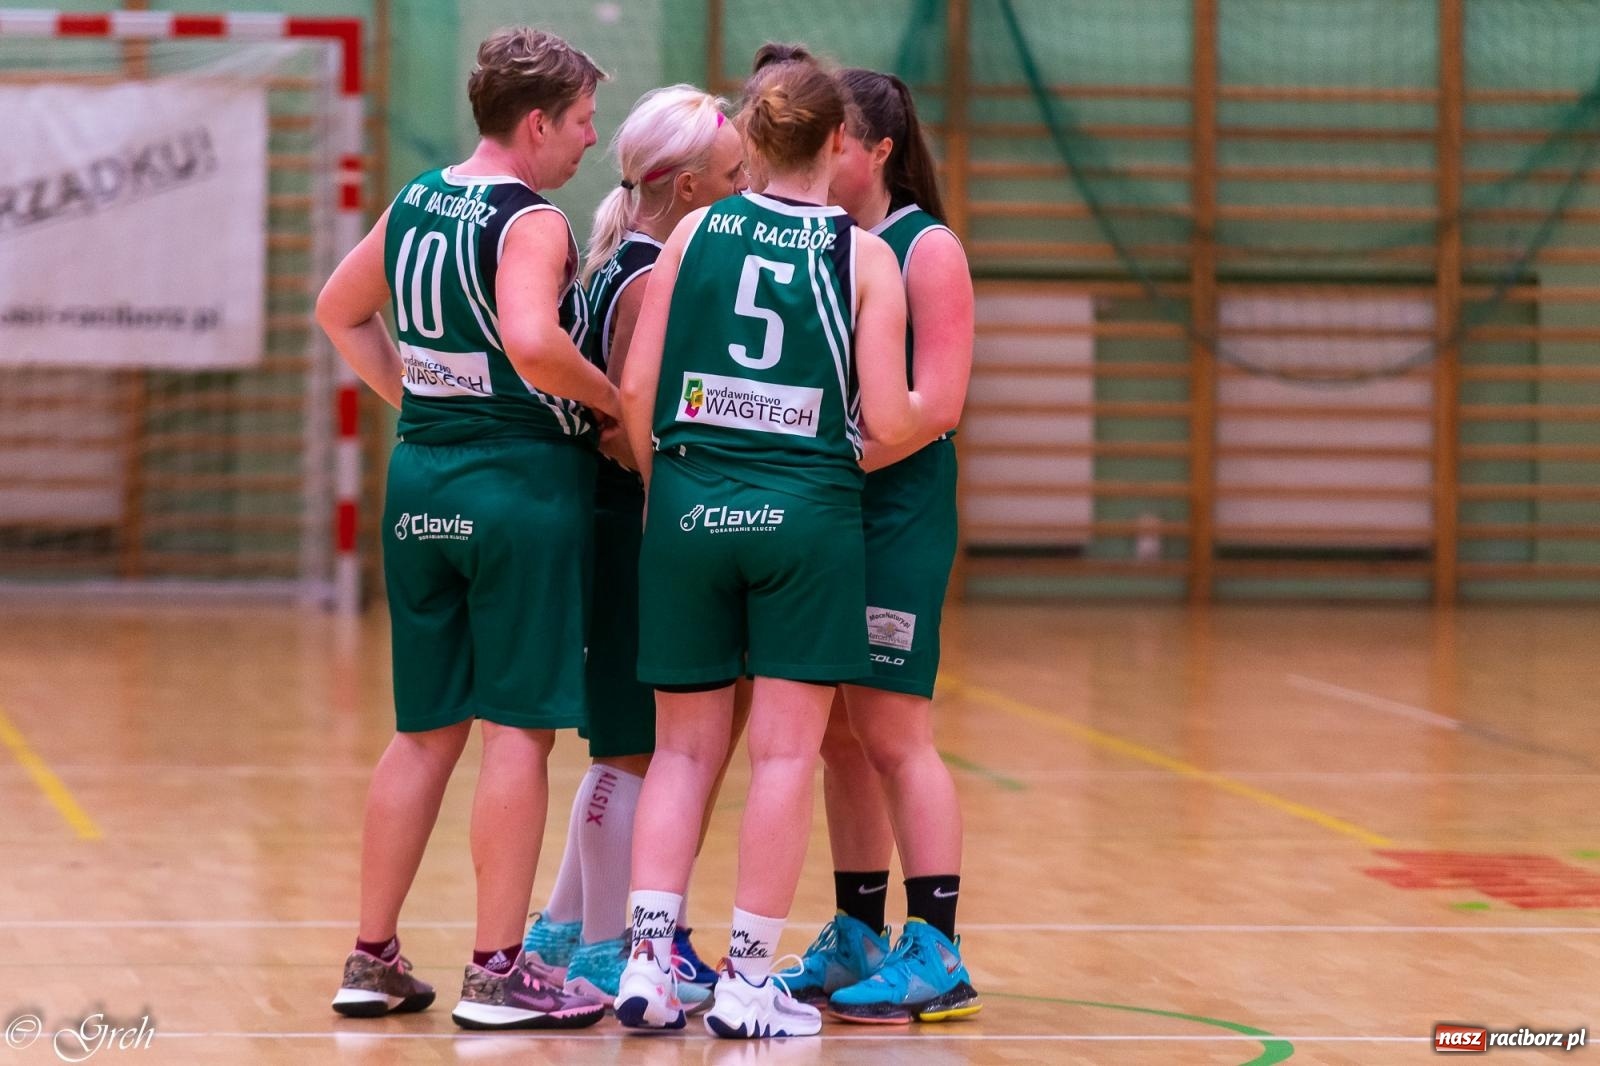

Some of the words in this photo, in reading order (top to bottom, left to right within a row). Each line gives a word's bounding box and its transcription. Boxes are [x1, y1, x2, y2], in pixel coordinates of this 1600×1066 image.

[707, 213, 748, 236] RKK
[395, 226, 447, 339] 10
[728, 254, 796, 371] 5
[706, 387, 781, 406] wydawnictwo
[705, 397, 813, 426] WAGTECH
[411, 512, 474, 535] Clavis
[703, 504, 785, 527] Clavis
